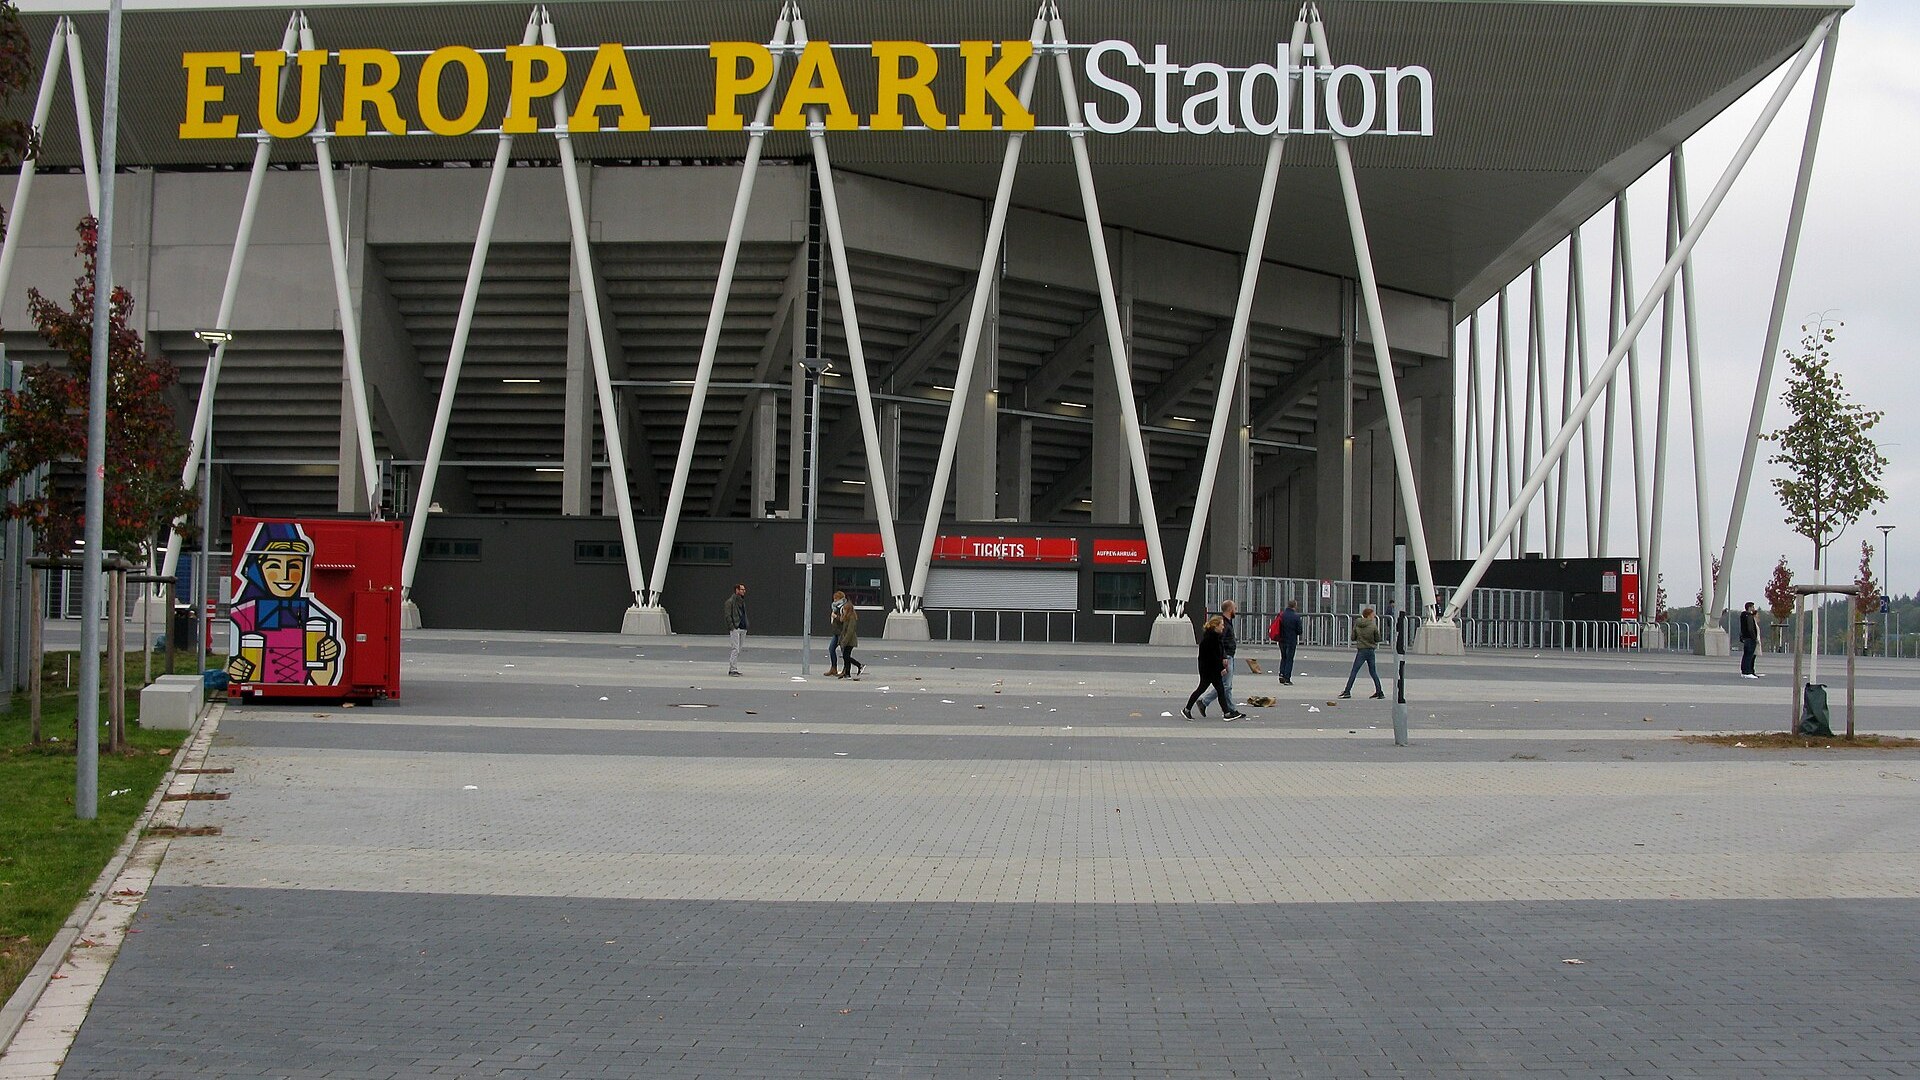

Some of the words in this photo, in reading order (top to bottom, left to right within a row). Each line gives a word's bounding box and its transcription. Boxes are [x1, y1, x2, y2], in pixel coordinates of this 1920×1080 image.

[179, 41, 651, 139] EUROPA
[707, 39, 1036, 132] PARK
[1084, 39, 1434, 137] Stadion
[973, 543, 1024, 557] TICKETS
[1624, 563, 1635, 573] E1
